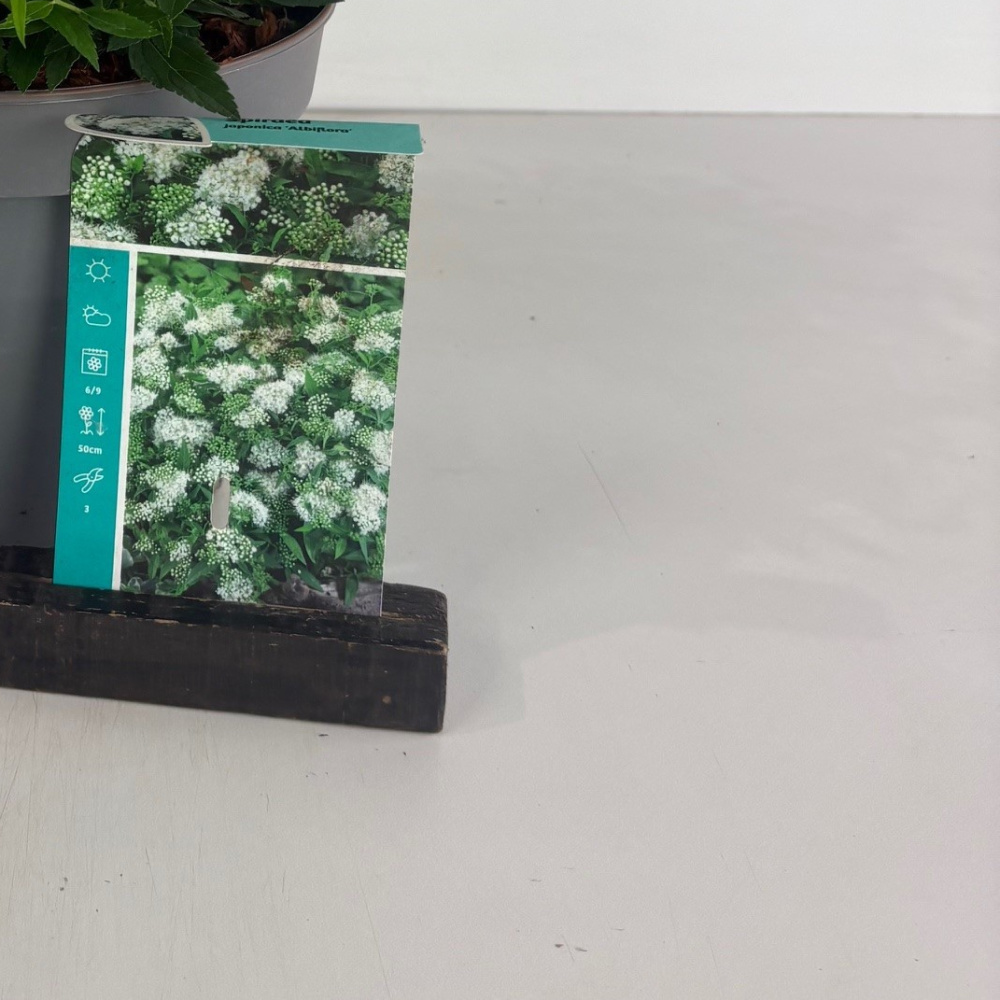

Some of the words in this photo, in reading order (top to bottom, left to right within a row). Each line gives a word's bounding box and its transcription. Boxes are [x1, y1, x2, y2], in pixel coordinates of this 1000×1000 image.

[85, 385, 101, 396] 6/9
[78, 444, 103, 455] 50cm
[84, 504, 90, 513] 3
